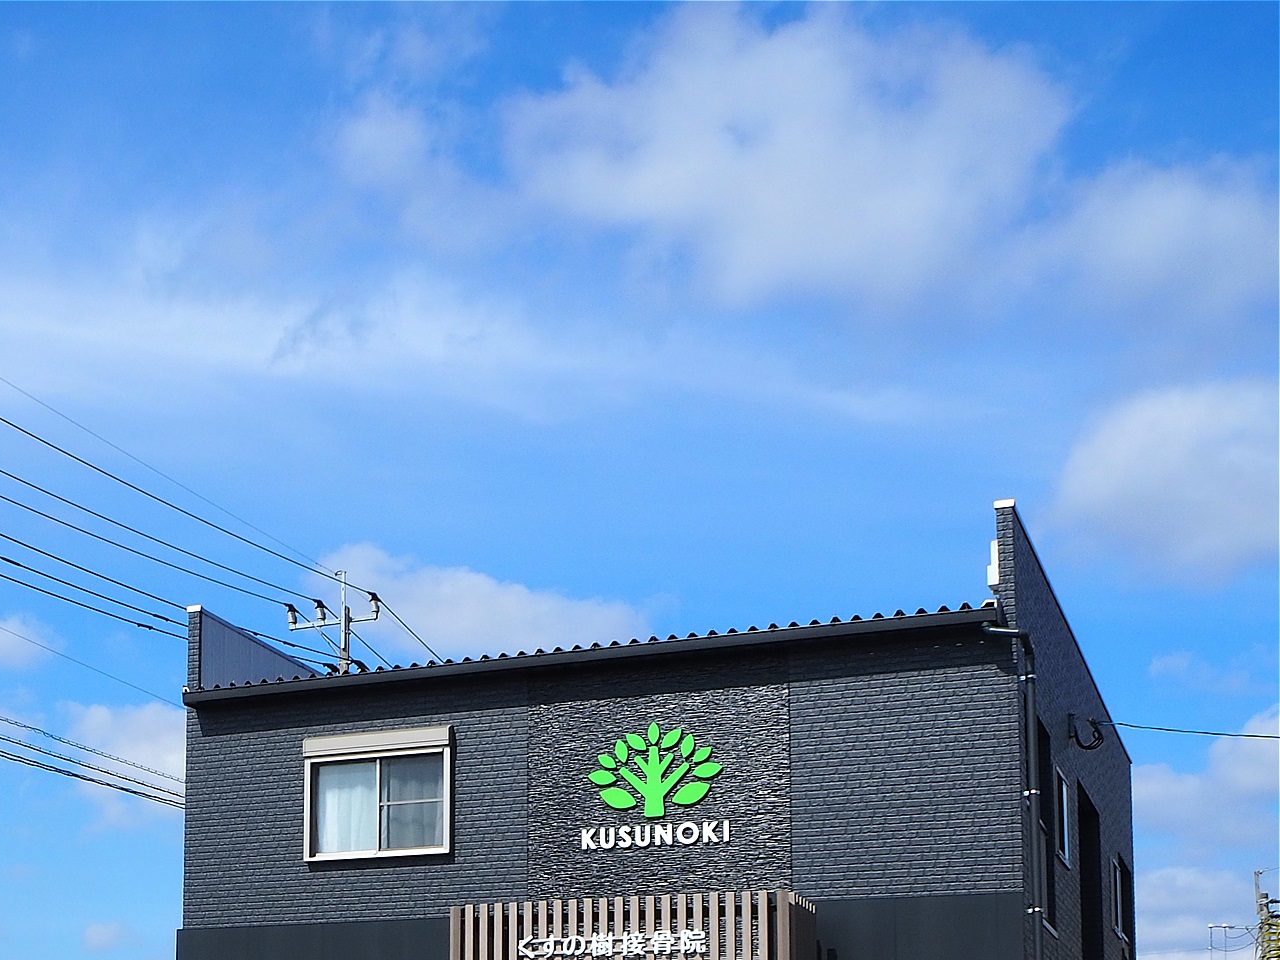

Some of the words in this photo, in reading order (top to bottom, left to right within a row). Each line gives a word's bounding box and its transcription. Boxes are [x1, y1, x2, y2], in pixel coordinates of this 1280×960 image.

[580, 819, 731, 850] KUSUNOKI
[517, 928, 706, 959] くすの樹接骨院
